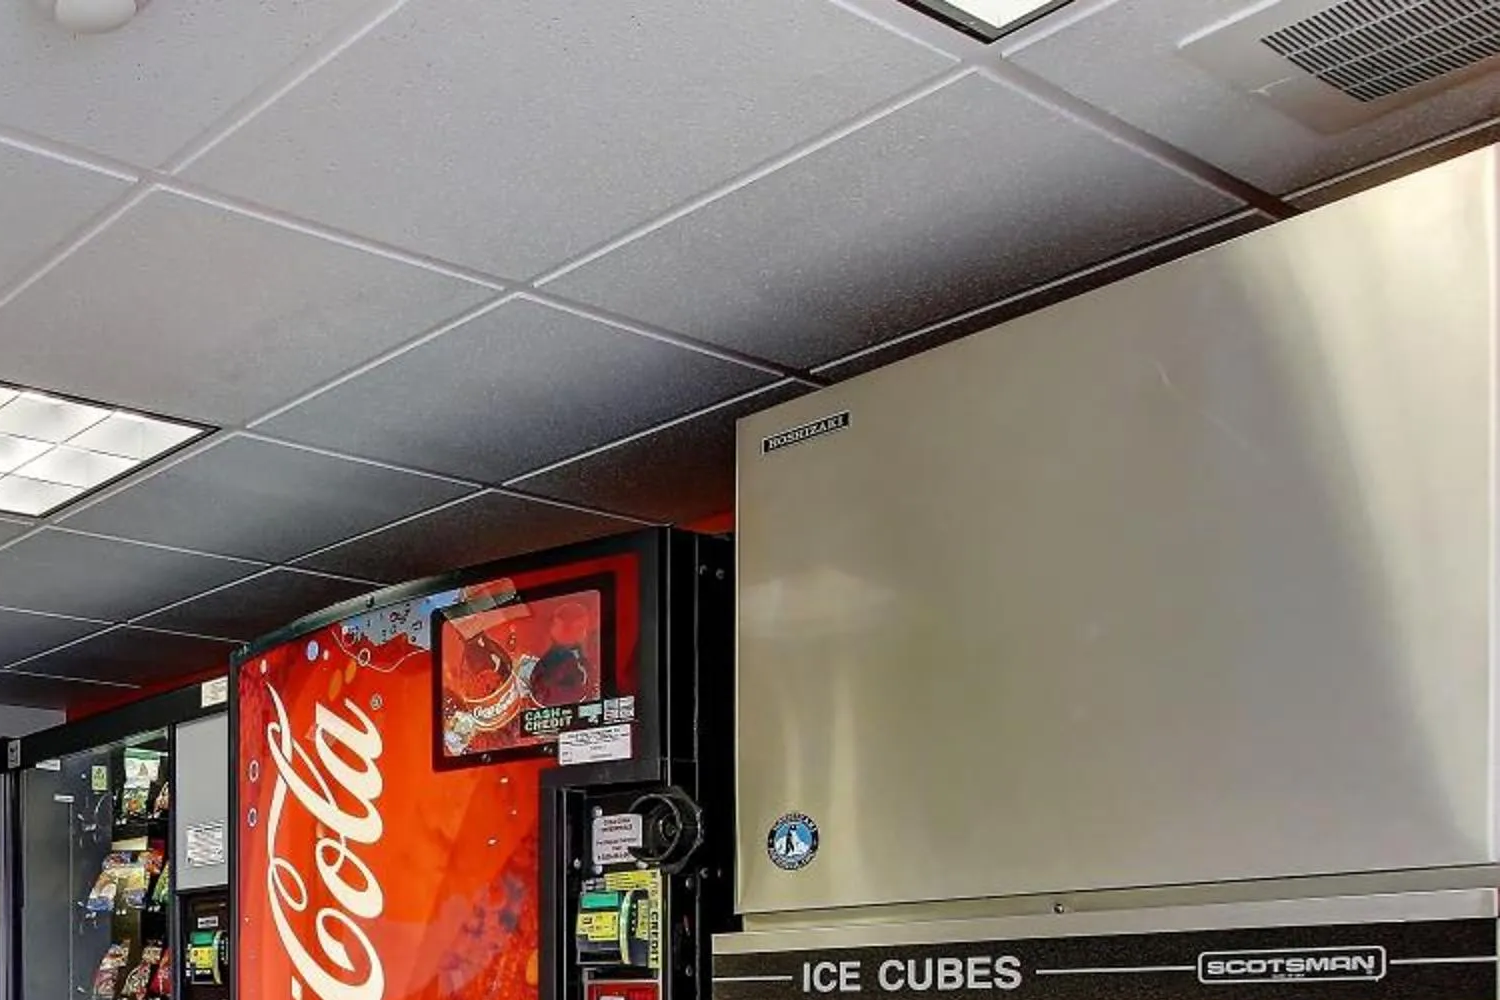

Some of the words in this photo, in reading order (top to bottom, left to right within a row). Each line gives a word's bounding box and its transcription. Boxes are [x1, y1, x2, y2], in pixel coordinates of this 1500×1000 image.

[768, 416, 844, 449] HOSHIZAKI
[525, 708, 561, 721] CASH
[525, 716, 572, 732] CREDIT
[803, 960, 862, 993] ICE
[877, 955, 1023, 992] CUBES
[1207, 955, 1376, 976] SCOTSMAN
